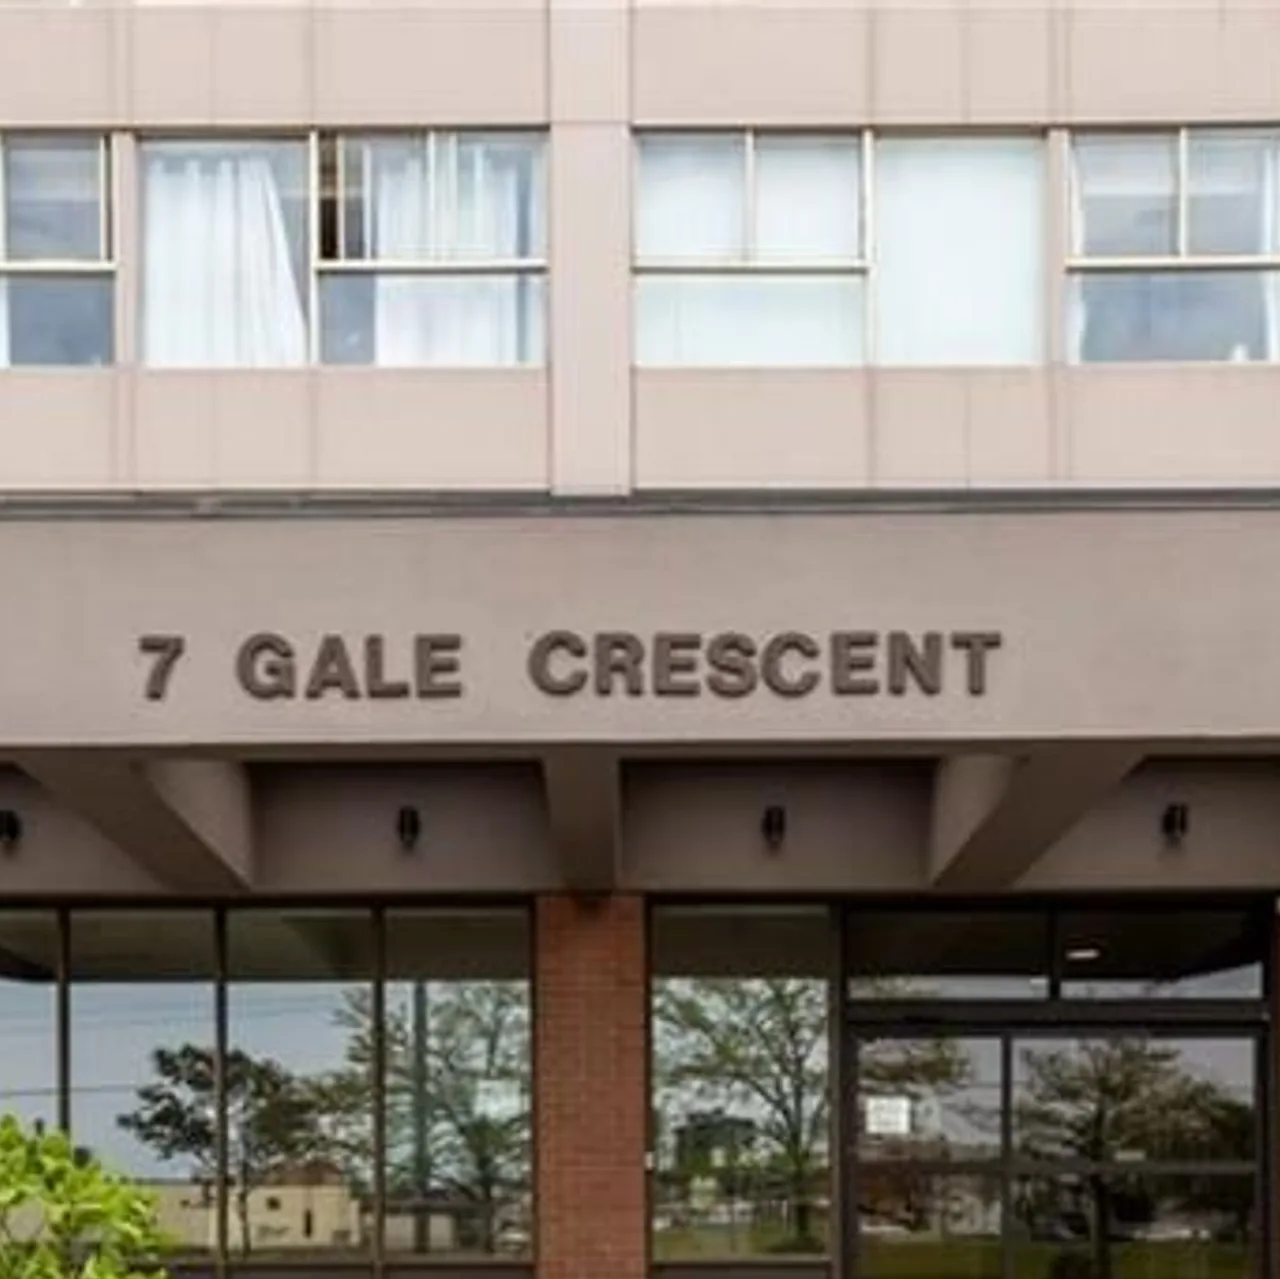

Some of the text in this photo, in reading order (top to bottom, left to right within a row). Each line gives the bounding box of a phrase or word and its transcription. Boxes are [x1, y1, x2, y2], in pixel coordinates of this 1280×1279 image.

[138, 631, 1004, 701] 7 GALE CRESCENT
